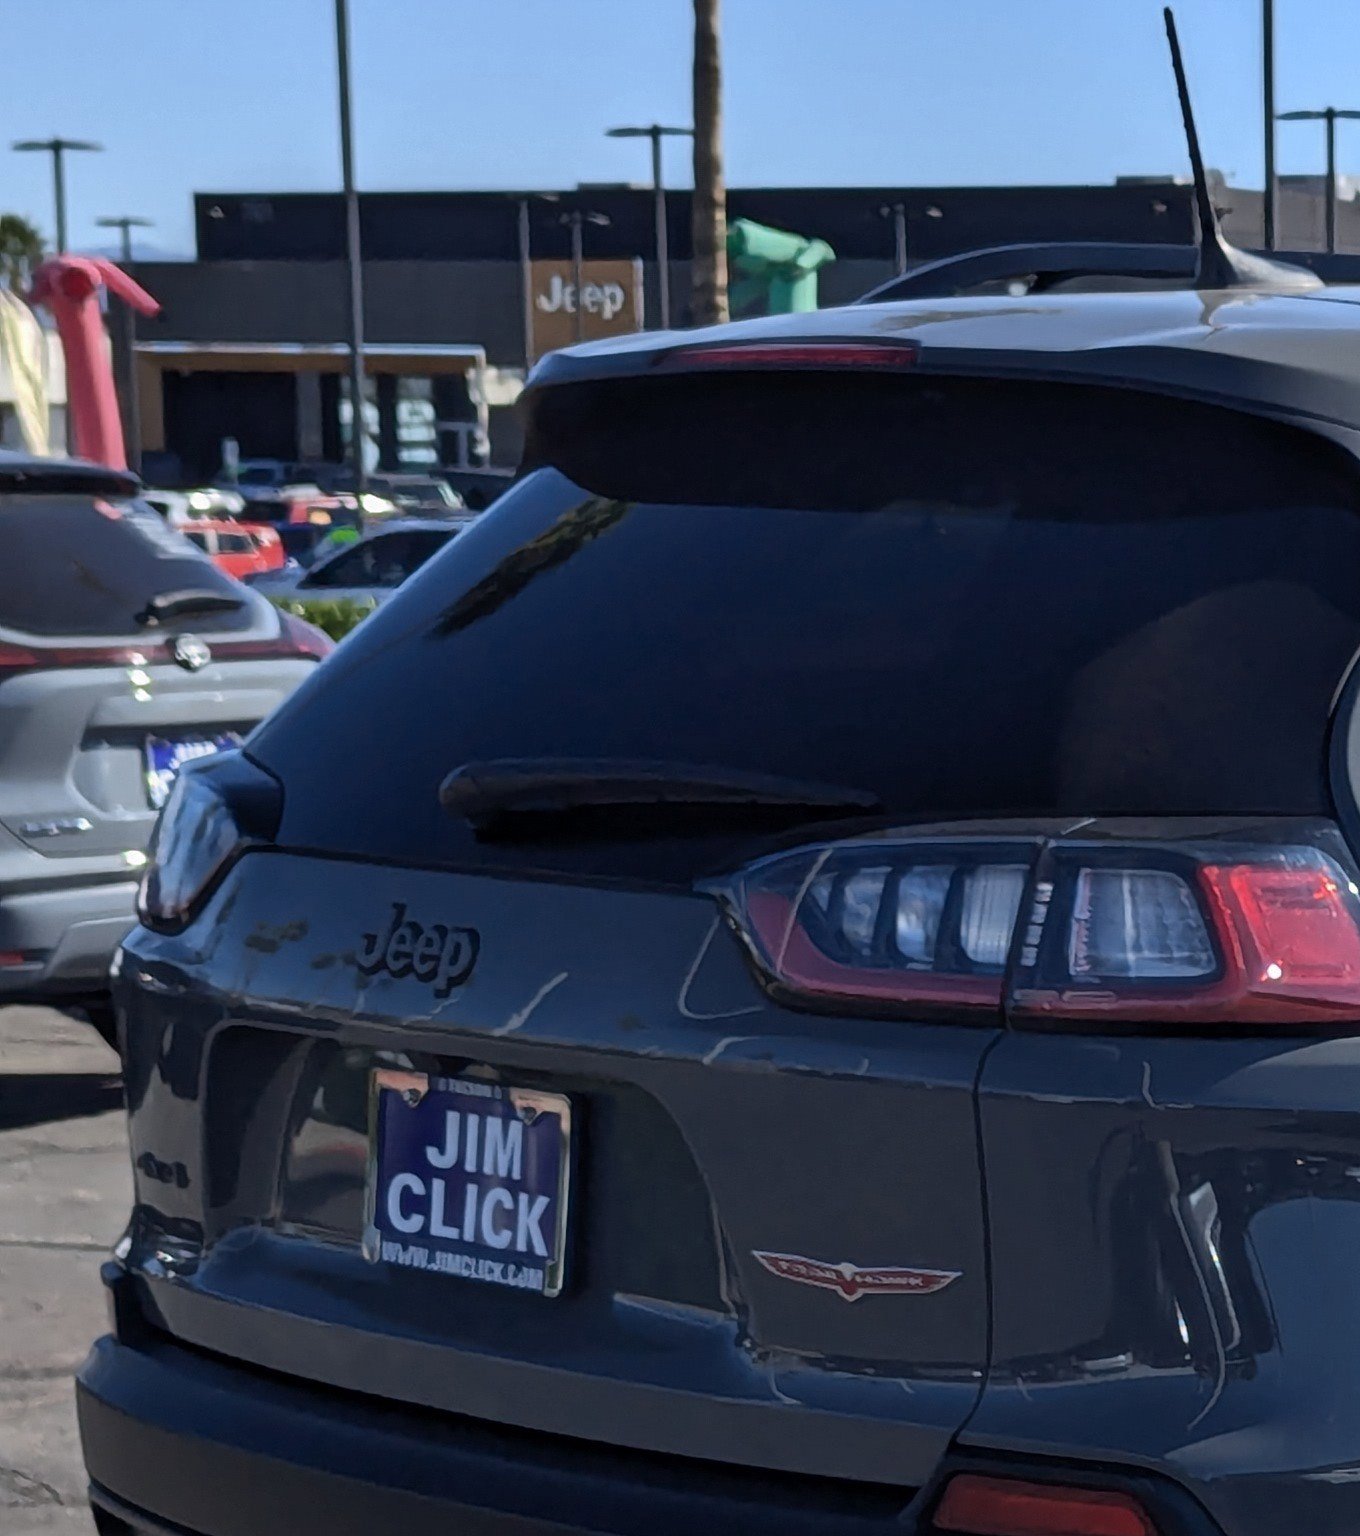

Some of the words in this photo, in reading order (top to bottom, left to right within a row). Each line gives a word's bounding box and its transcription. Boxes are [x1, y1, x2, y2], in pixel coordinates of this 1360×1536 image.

[536, 274, 625, 320] Jeep
[356, 903, 480, 998] Jeep
[426, 1110, 524, 1180] JIM
[387, 1172, 551, 1257] CLICK
